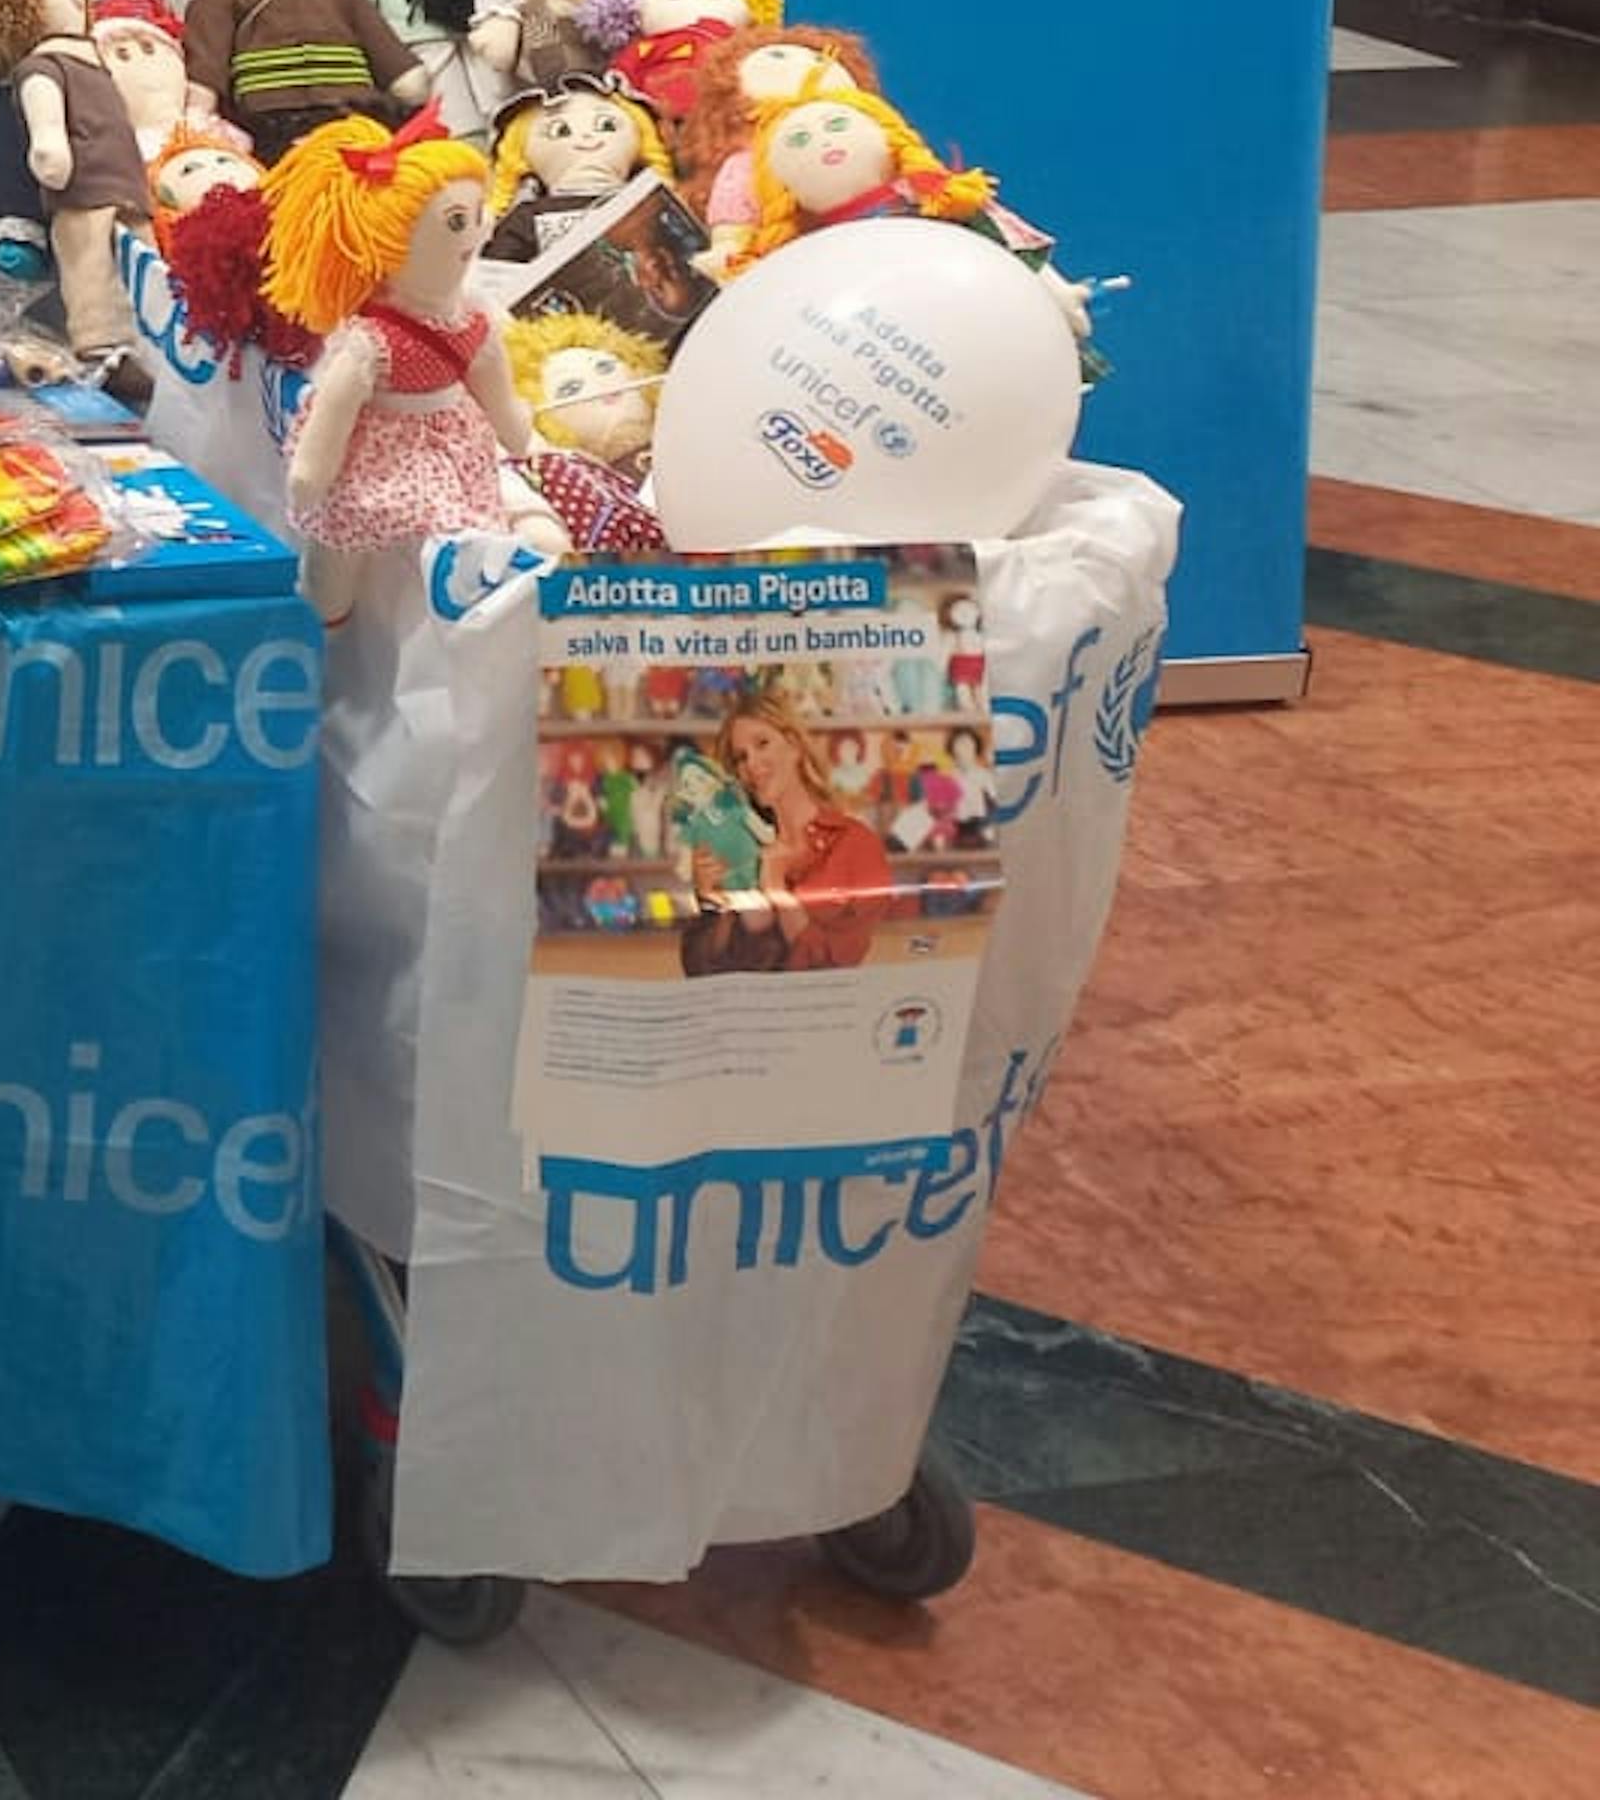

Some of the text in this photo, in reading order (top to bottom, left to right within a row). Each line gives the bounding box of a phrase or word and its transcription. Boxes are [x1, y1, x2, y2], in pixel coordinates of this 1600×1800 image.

[856, 305, 947, 380] Adotta
[768, 346, 882, 429] unicef
[761, 415, 837, 482] Foxy
[566, 572, 870, 611] Adotta una Pigotta
[567, 623, 926, 657] salva la vita di un bambino
